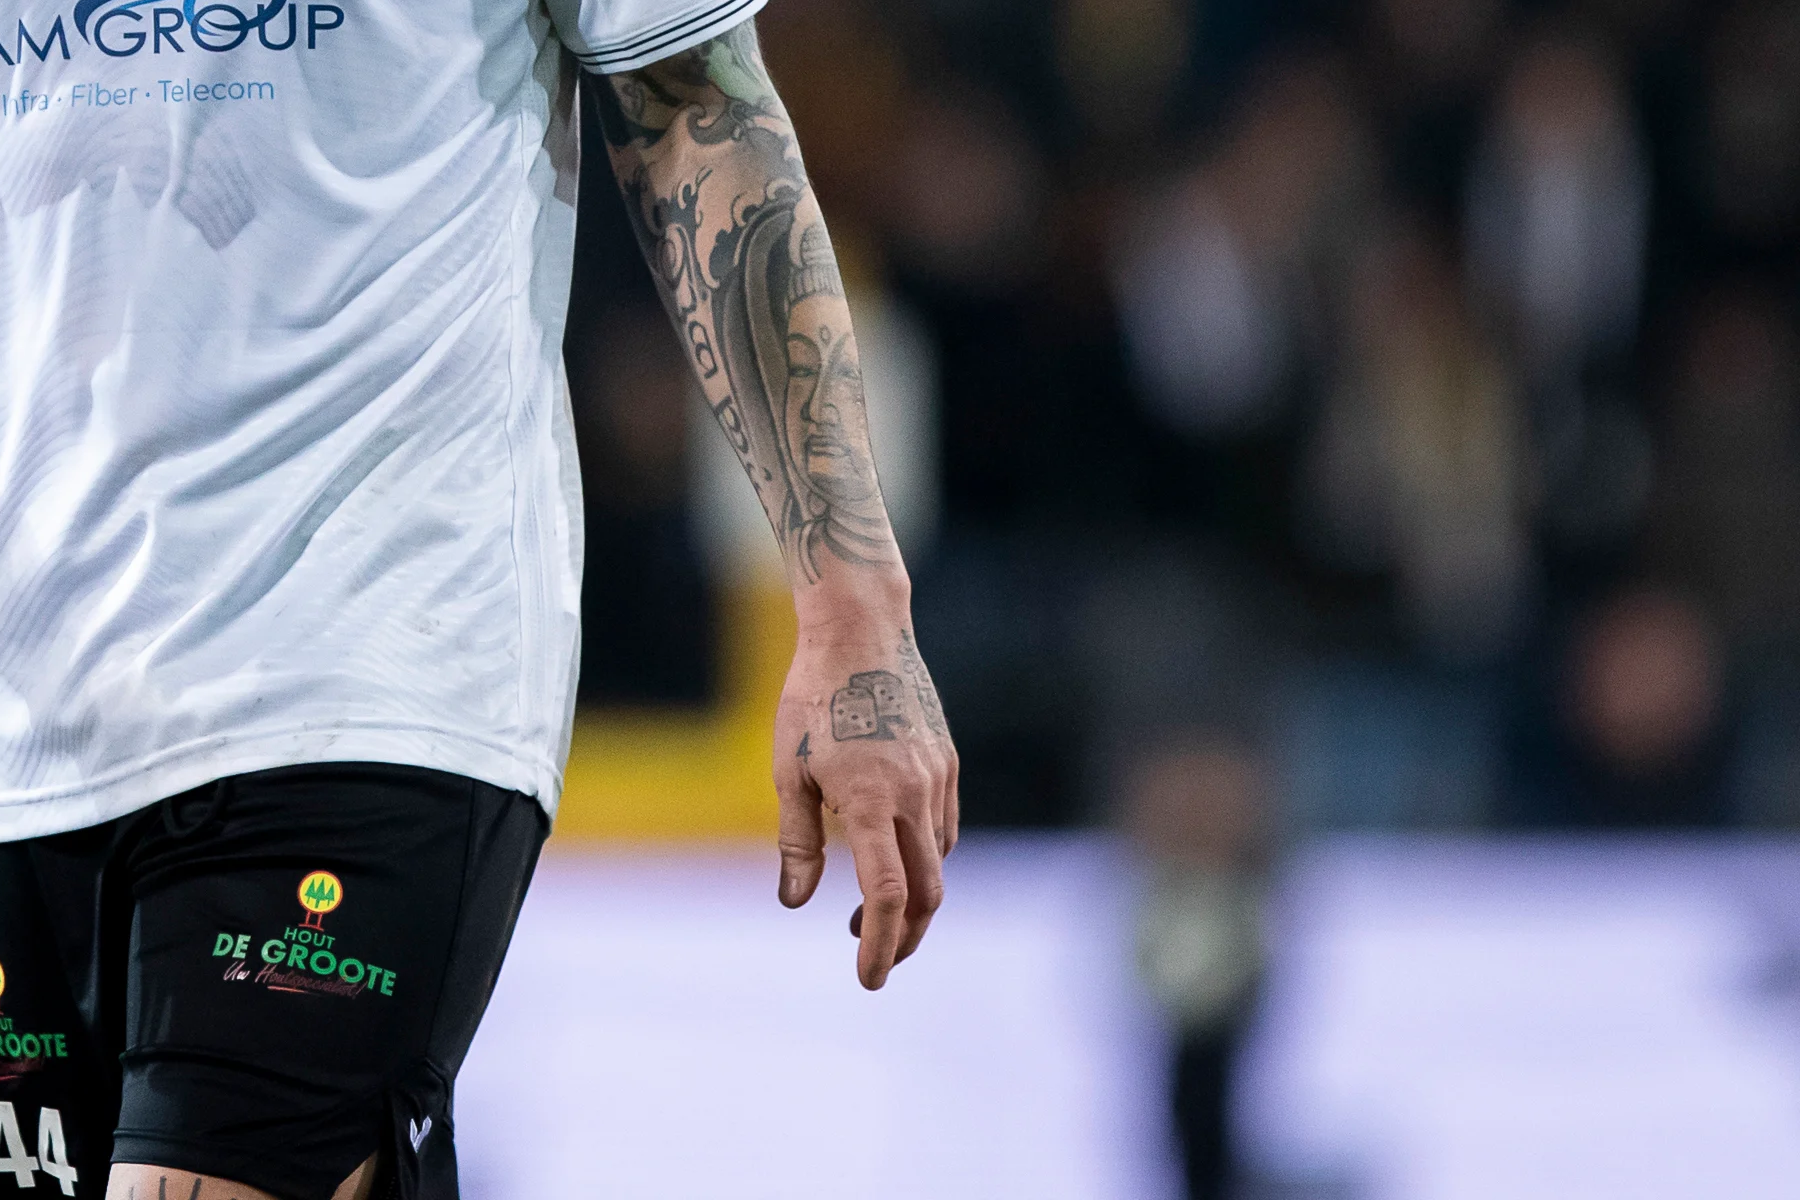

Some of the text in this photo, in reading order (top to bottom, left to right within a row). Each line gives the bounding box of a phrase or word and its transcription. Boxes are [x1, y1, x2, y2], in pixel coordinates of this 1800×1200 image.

[93, 2, 345, 58] GROUP
[1, 78, 275, 117] Infra Fiber Telecom
[283, 926, 337, 950] HOUT
[212, 932, 397, 997] DE GROOTE
[223, 960, 251, 981] Uw
